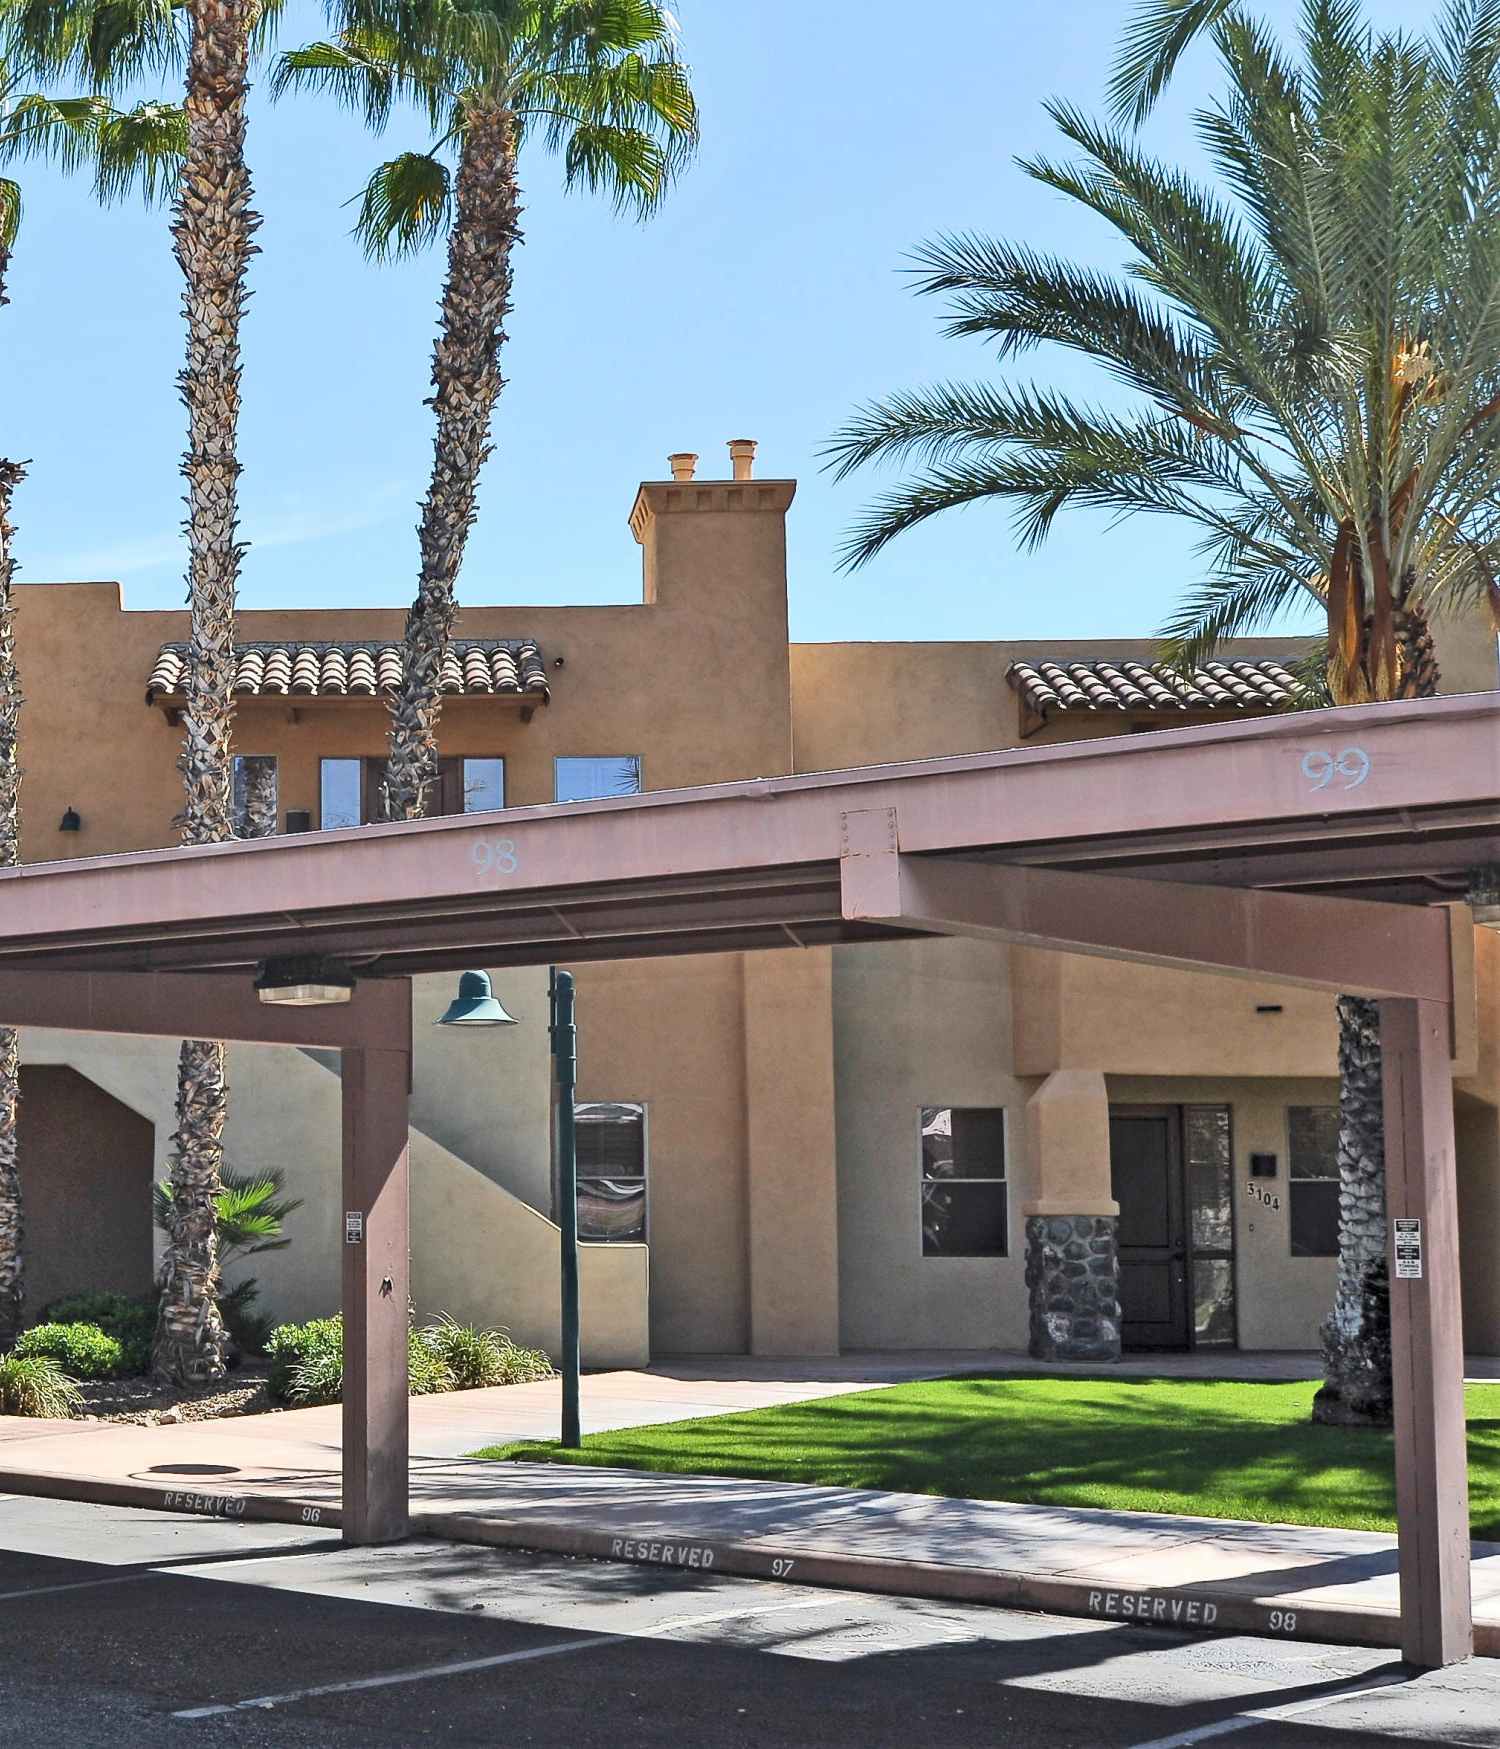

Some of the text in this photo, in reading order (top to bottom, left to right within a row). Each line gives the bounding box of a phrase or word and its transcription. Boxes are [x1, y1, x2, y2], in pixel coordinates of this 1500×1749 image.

[1302, 747, 1370, 794] 99
[471, 839, 520, 876] 98
[1247, 1182, 1280, 1211] 3104
[164, 1492, 321, 1522] RESERVED 96
[611, 1539, 795, 1577] RESERVED 97
[1088, 1591, 1297, 1631] RESERVED 98
